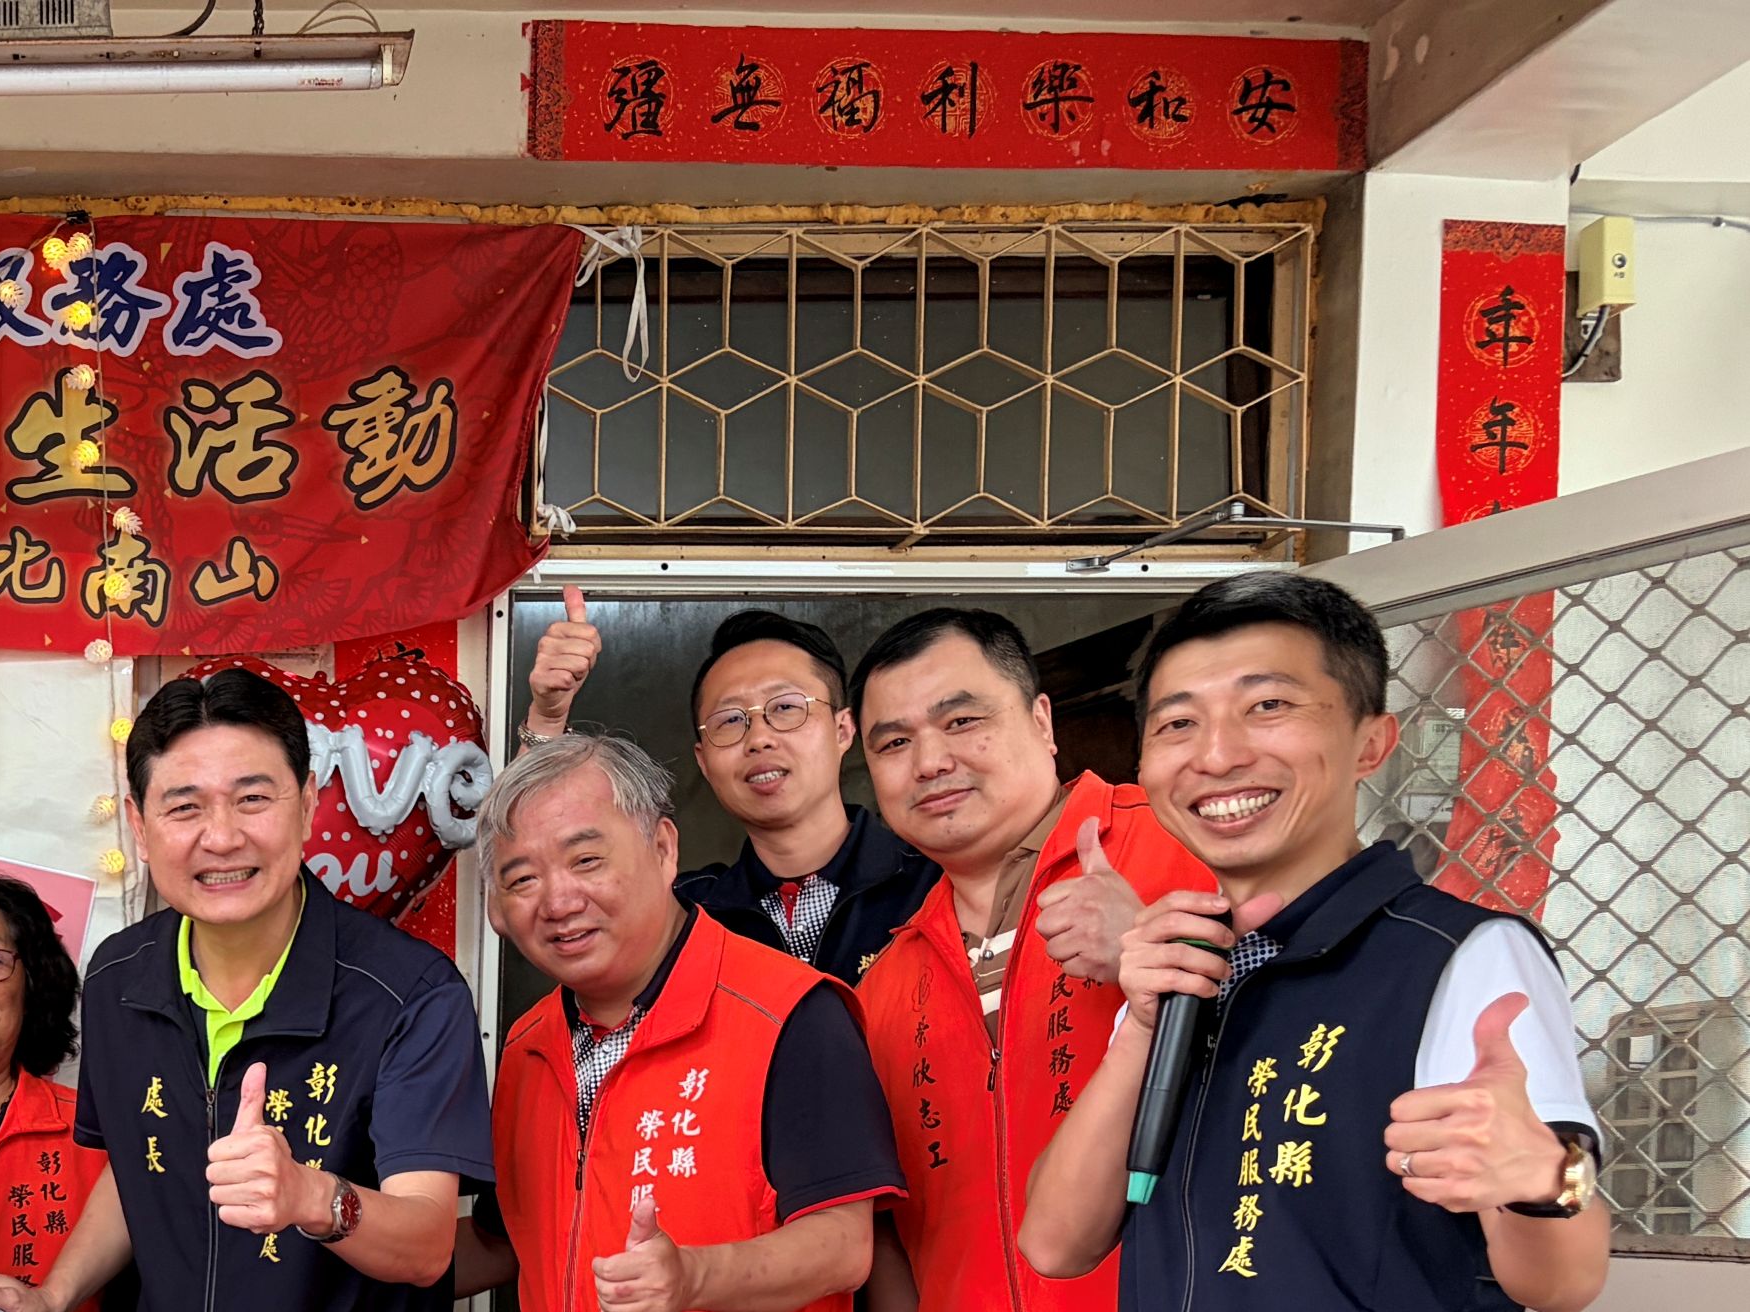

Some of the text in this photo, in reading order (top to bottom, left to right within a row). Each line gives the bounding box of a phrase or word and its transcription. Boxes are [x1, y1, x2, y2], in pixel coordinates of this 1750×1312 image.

[1469, 285, 1534, 519] 年年
[1047, 959, 1076, 1119] 民服務處
[1268, 1023, 1347, 1188] 彰化縣
[37, 1150, 70, 1236] 彰化縣
[141, 1076, 169, 1174] 處長
[666, 1067, 711, 1179] 彰化縣
[1217, 1057, 1279, 1279] 榮民服務處
